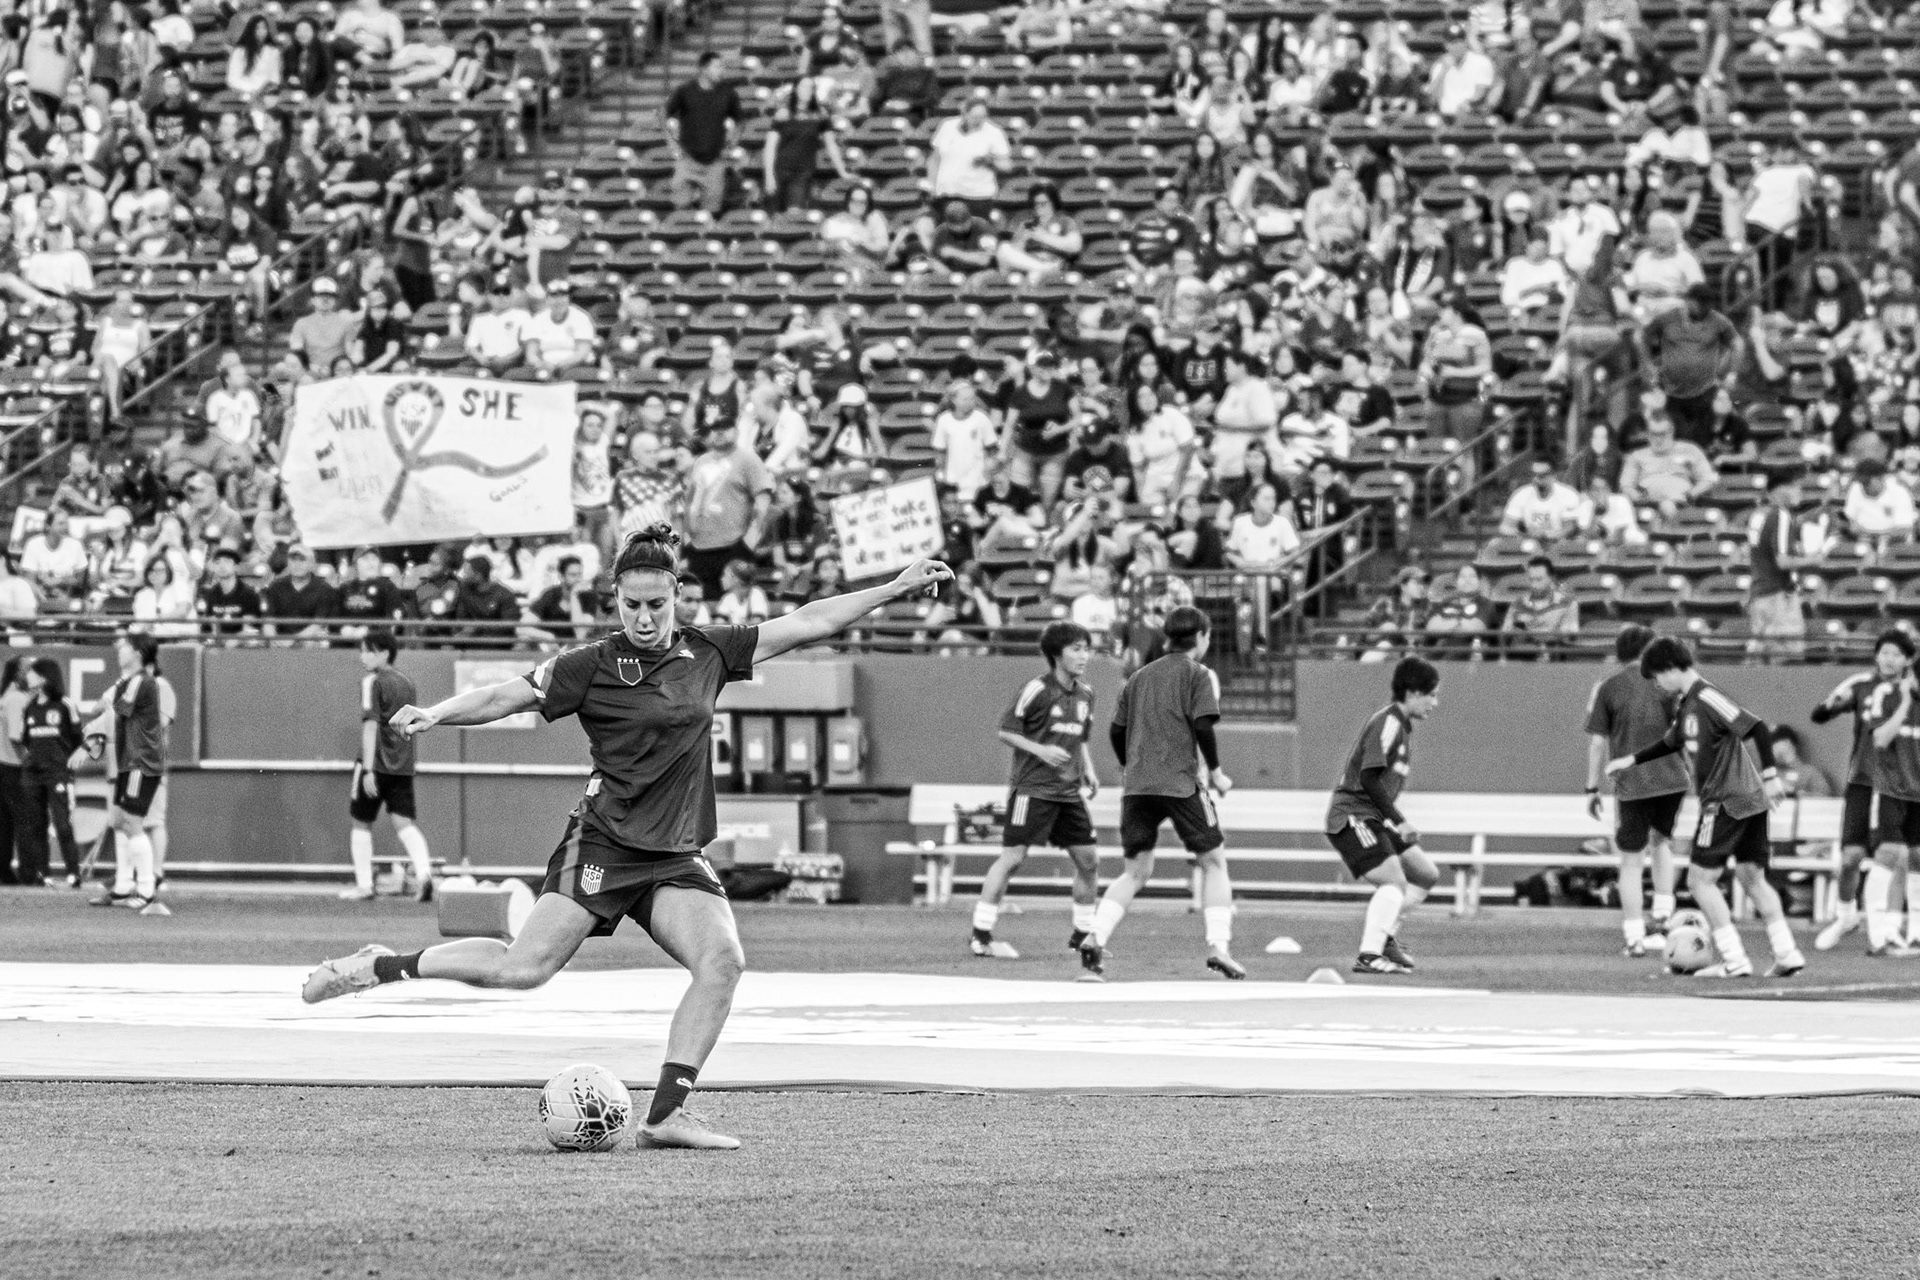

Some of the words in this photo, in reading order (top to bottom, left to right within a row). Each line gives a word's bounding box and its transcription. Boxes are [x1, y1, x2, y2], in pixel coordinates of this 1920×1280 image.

[384, 381, 445, 409] USWNT
[459, 387, 523, 421] SHE
[584, 869, 601, 881] USA
